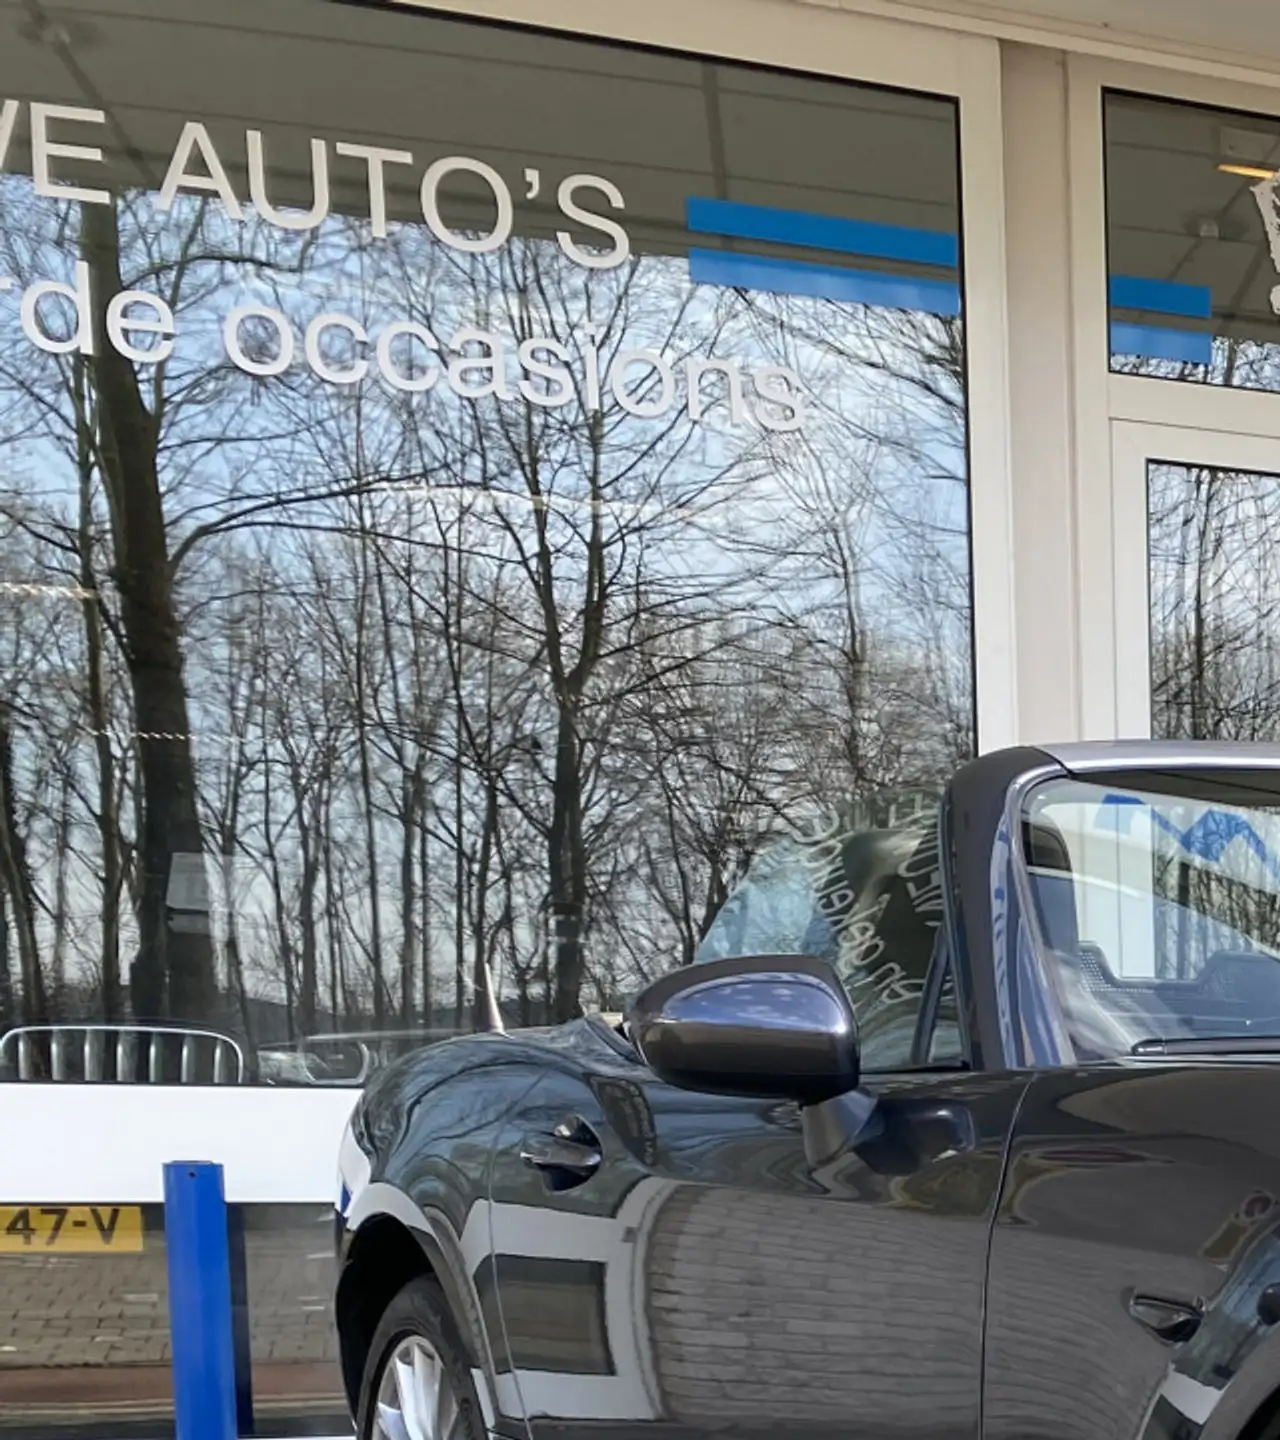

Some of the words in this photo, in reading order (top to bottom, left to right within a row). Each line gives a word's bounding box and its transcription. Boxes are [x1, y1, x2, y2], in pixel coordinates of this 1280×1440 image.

[0, 98, 111, 205] E
[157, 122, 631, 270] AUTO'S
[222, 303, 806, 431] occasions
[5, 1207, 120, 1245] 47-V
